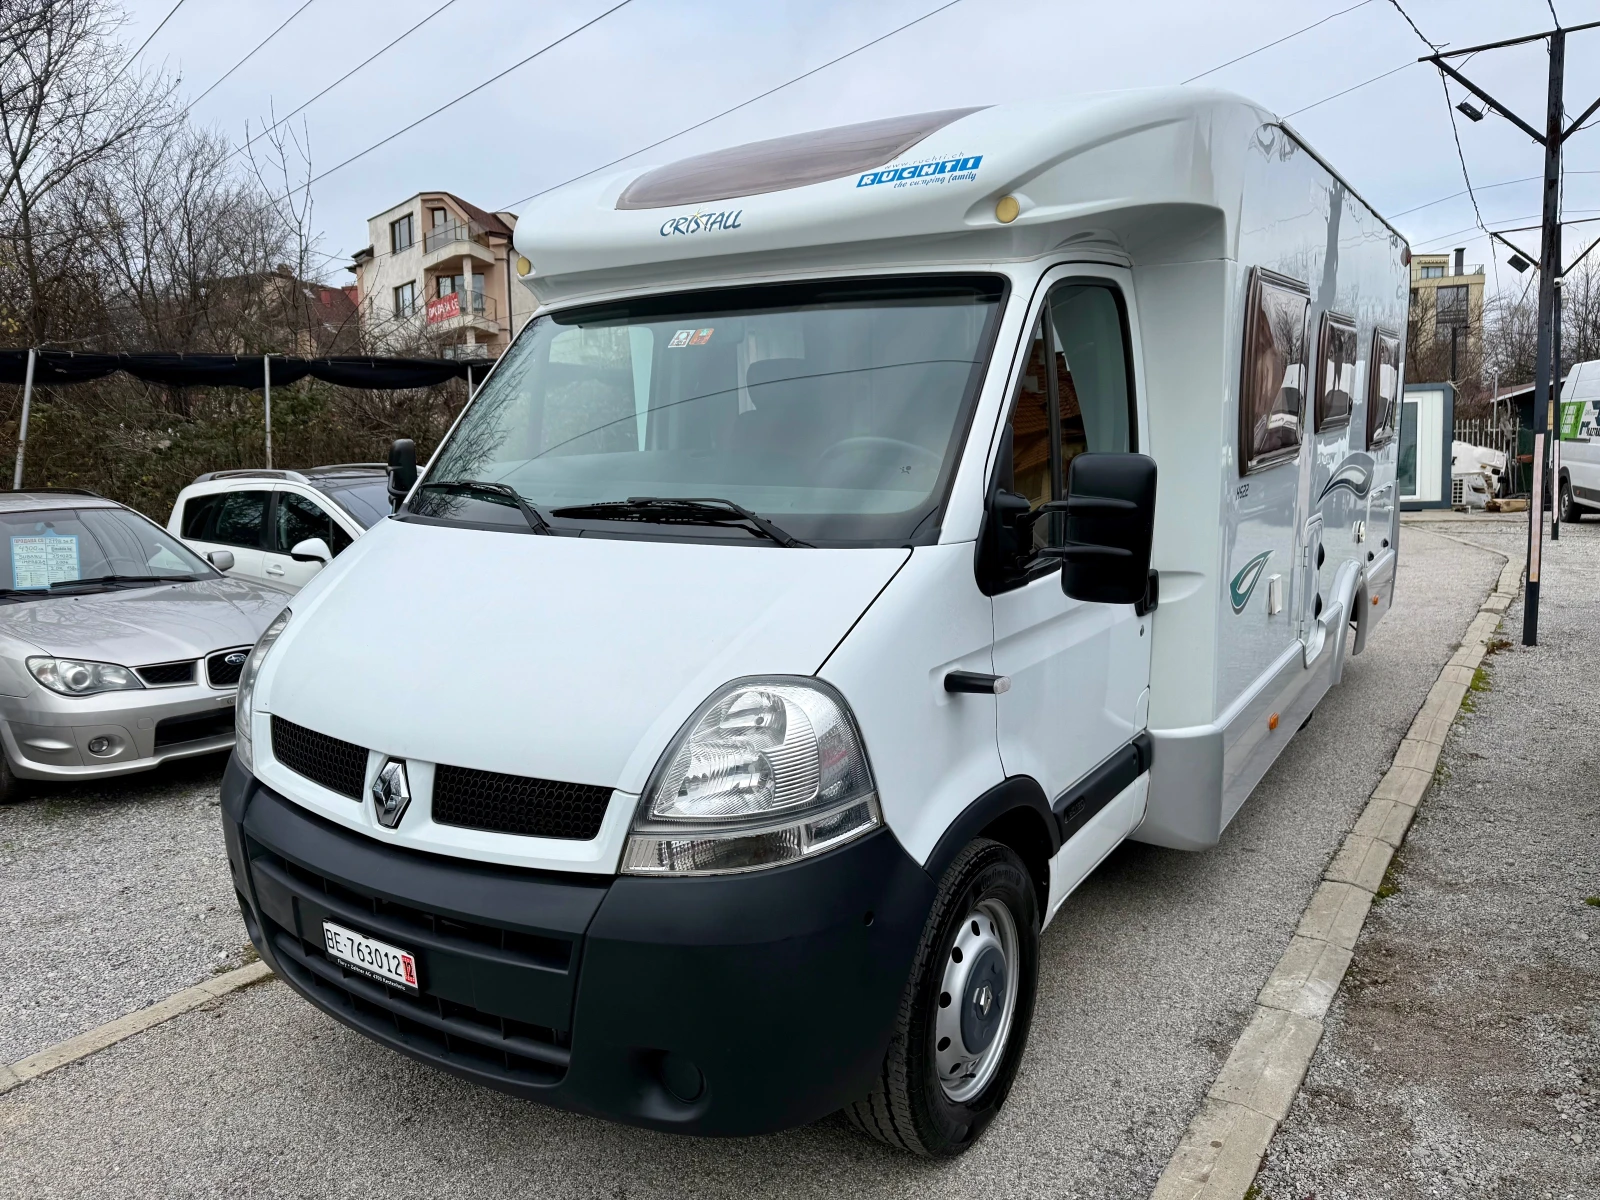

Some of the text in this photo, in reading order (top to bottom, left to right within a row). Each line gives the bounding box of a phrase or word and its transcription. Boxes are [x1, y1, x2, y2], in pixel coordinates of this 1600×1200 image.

[858, 157, 981, 187] RUCHTI
[884, 151, 965, 170] www.ruchti.ch
[893, 171, 977, 189] the camping family
[660, 210, 743, 237] CRISTALL
